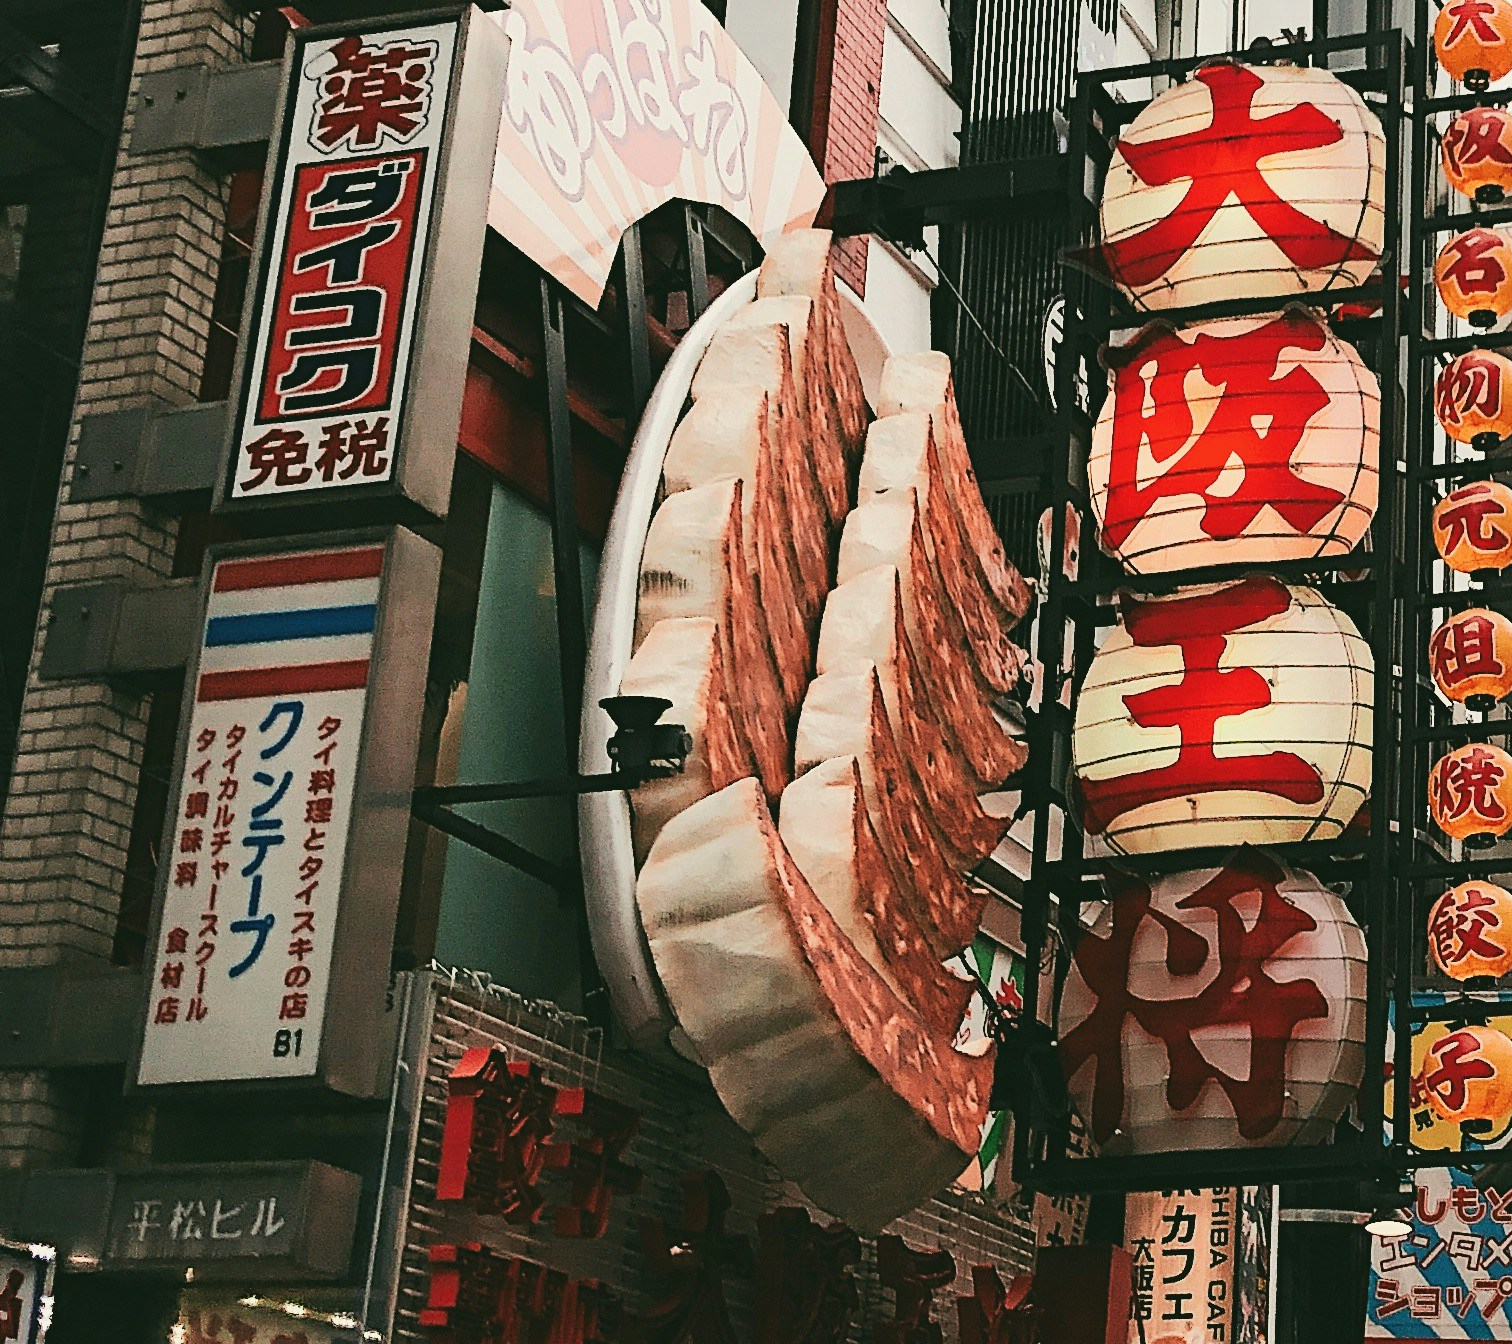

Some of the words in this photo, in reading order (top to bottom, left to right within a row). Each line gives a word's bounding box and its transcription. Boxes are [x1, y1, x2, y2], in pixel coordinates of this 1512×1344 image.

[304, 36, 440, 153] 薬
[275, 157, 415, 417] ダイコク
[239, 417, 390, 492] 免税
[1058, 58, 1391, 1144] 大阪王将
[174, 726, 217, 888] タイ調味料
[185, 722, 246, 1023] タイカルチャースクール
[228, 700, 304, 979] クンテープ
[278, 715, 341, 1022] タイ料理とタイスキの店
[154, 927, 190, 1025] 食材店
[273, 1028, 303, 1058] B1
[1160, 1189, 1200, 1320] カフェ
